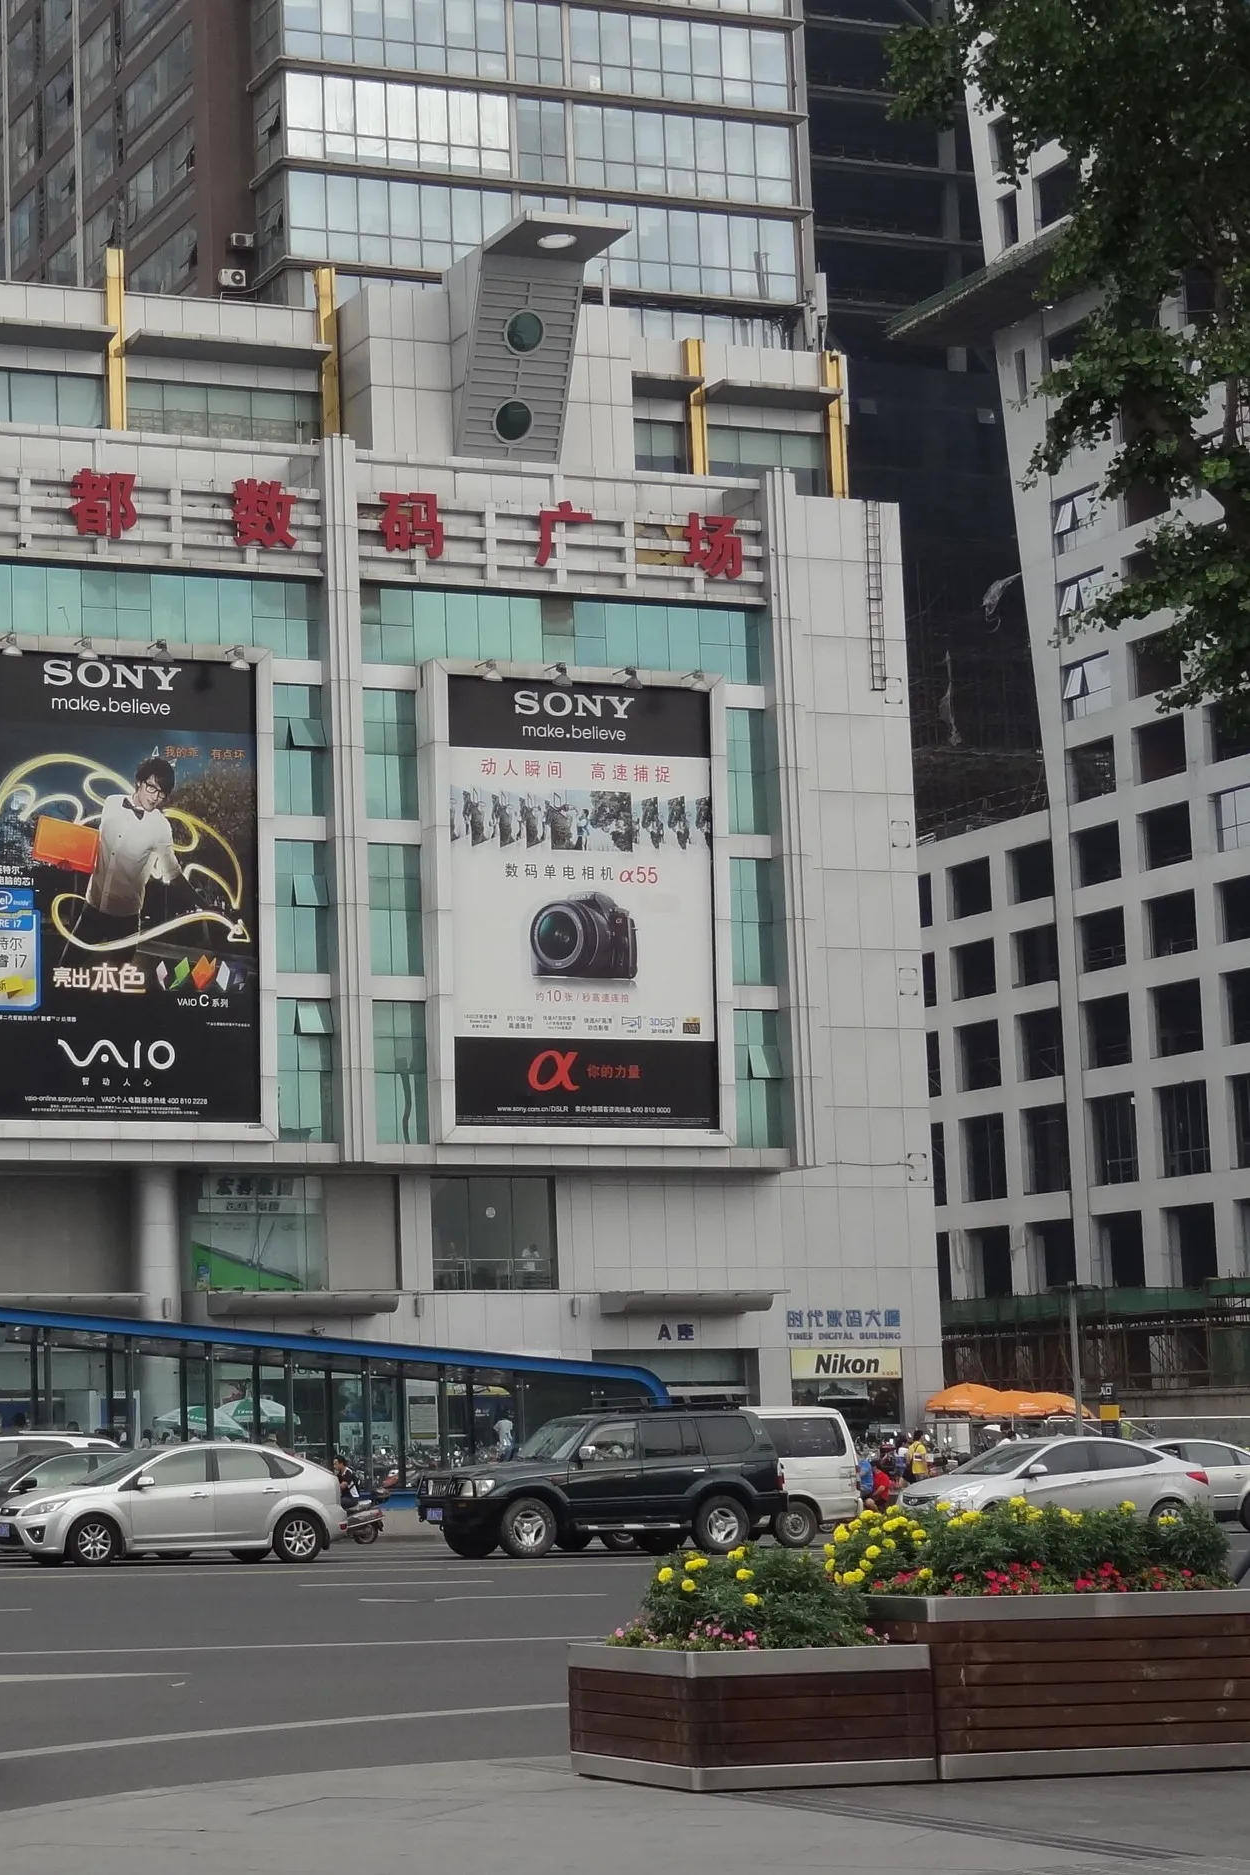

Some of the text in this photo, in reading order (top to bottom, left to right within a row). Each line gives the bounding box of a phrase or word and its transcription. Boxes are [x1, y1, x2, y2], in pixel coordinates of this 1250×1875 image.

[43, 660, 182, 691] SONY
[51, 695, 171, 715] make.believe
[514, 690, 634, 719] SONY
[522, 723, 627, 741] make.believe
[481, 758, 672, 784] 动人瞬间 高速捕捉
[505, 863, 614, 882] 数码单电相机
[14, 954, 27, 969] i7
[53, 962, 146, 993] 亮出本色
[177, 994, 229, 1008] VAIO C 系列
[58, 1038, 176, 1070] VAIO
[587, 1064, 642, 1080] 你的力量
[81, 1077, 152, 1087] 智动人心
[24, 1094, 95, 1104] vaio-online.sony.com/cn
[167, 1097, 179, 1105] 400
[180, 1097, 191, 1105] 810
[192, 1097, 208, 1105] 2228
[497, 1105, 569, 1114] www.sony.com.cn/DSLR
[632, 1106, 643, 1114] 400
[644, 1106, 655, 1114] 810
[656, 1106, 671, 1114] 9000
[787, 1331, 901, 1341] TIMES DIGITAL BUILDING
[815, 1353, 880, 1375] Nikon
